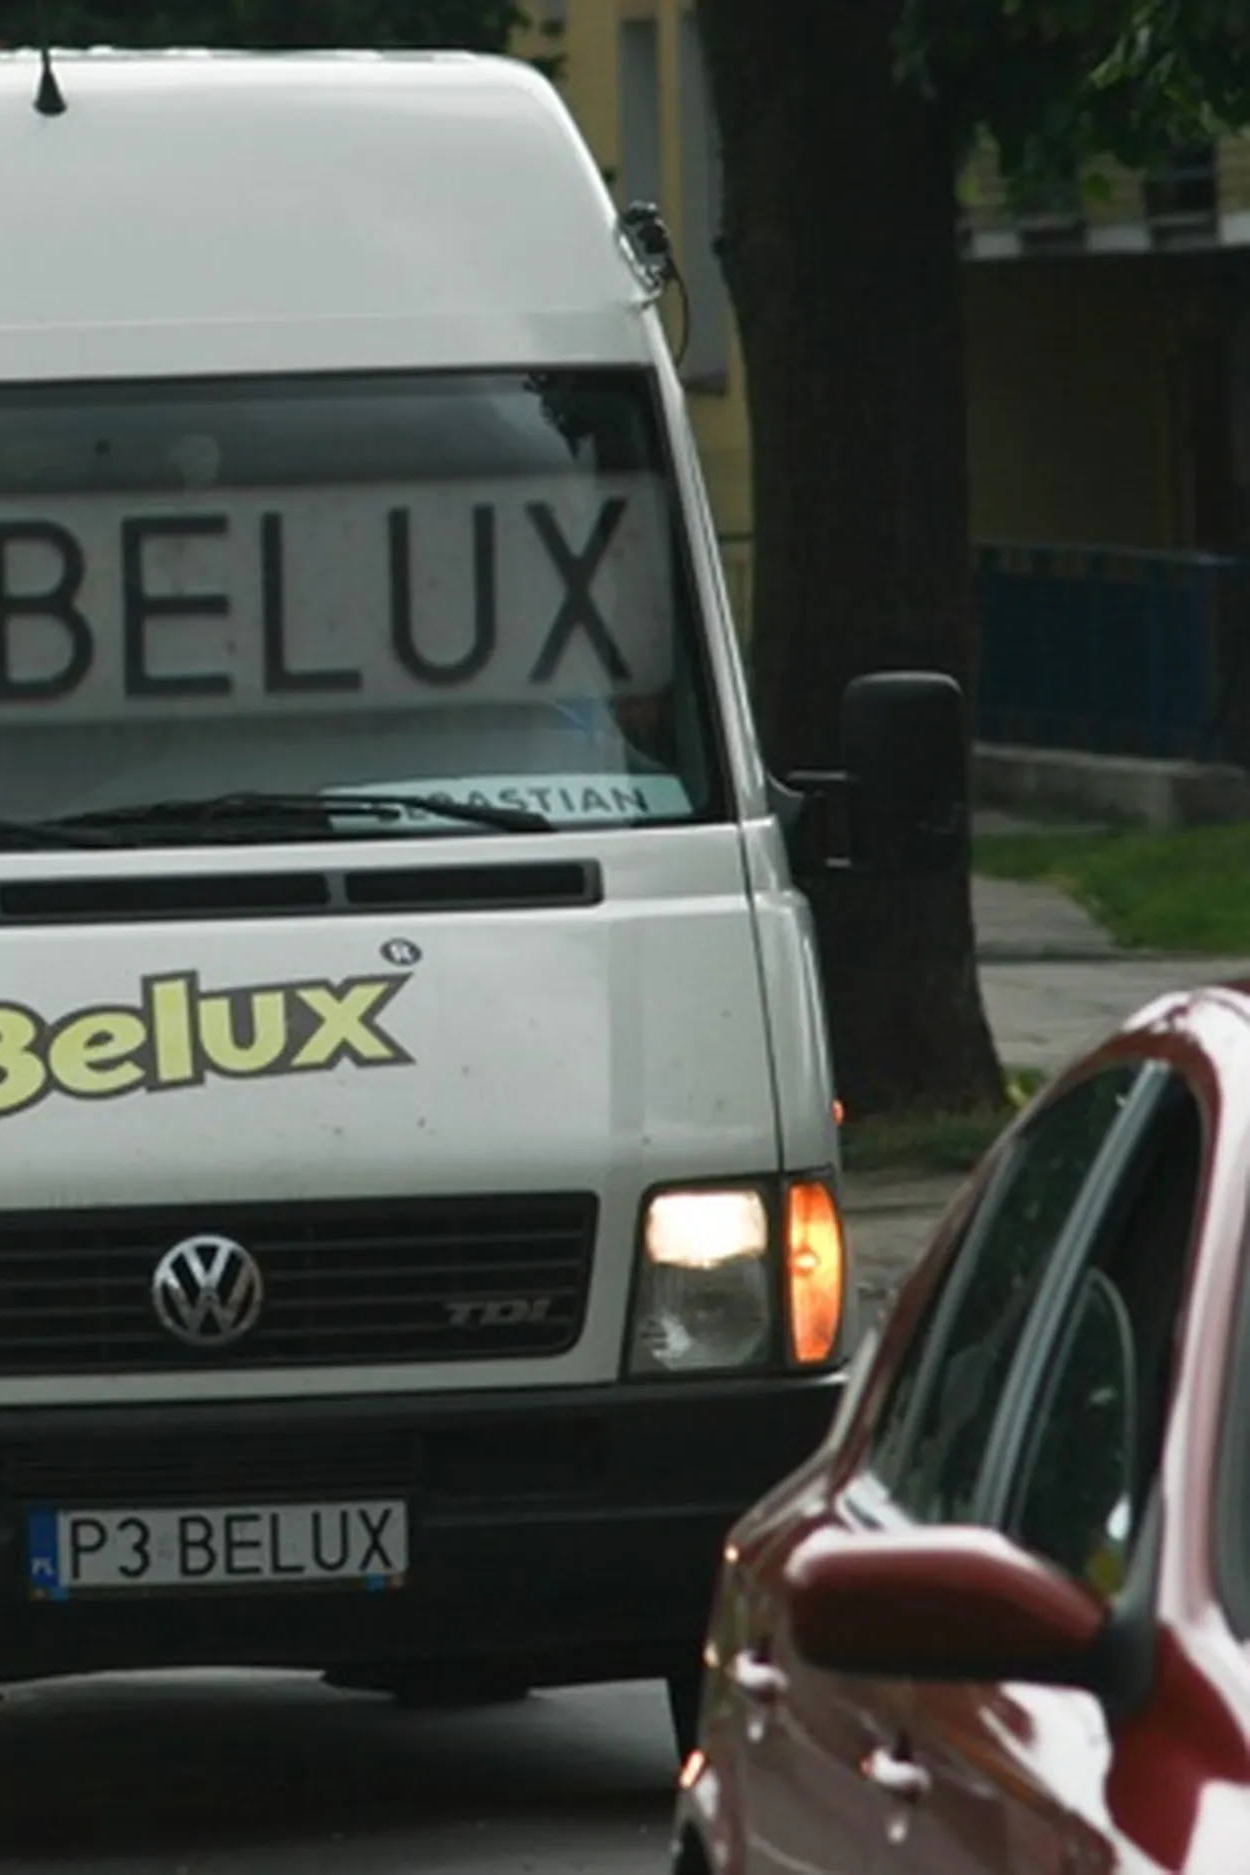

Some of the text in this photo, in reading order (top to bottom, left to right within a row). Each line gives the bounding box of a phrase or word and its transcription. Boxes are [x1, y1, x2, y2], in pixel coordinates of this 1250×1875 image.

[386, 786, 649, 823] EASTIAN
[443, 1298, 552, 1326] TDI
[69, 1508, 393, 1580] P3 BELUX
